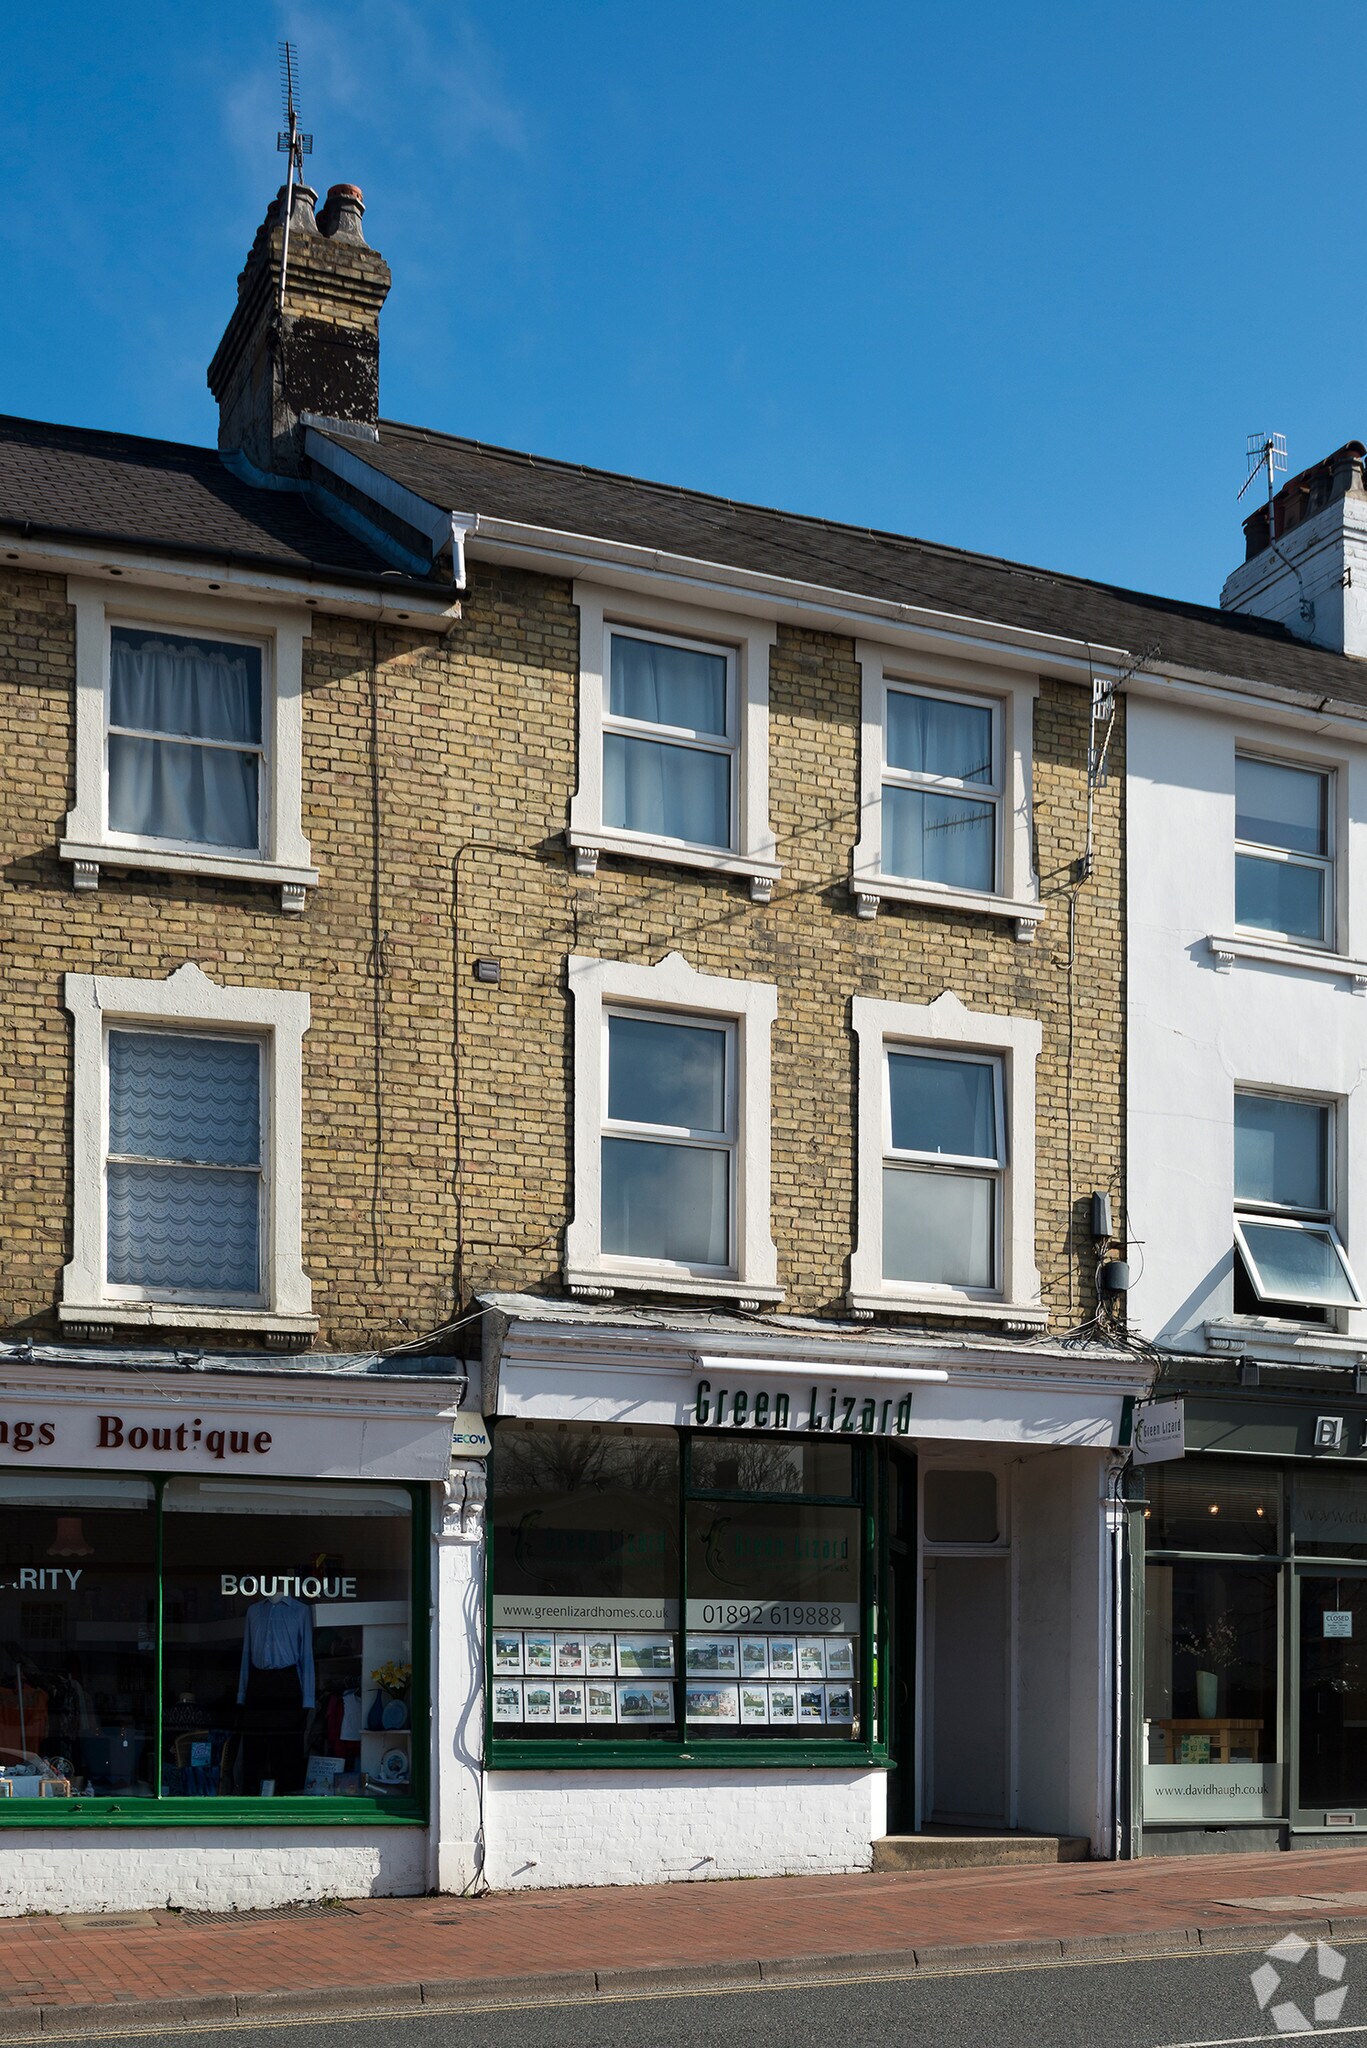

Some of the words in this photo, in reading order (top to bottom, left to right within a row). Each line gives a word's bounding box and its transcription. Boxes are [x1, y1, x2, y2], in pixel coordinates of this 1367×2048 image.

[695, 1379, 790, 1428] Green
[809, 1386, 913, 1435] Lizard
[96, 1415, 273, 1459] Boutique
[1143, 1423, 1161, 1438] Green
[1162, 1418, 1181, 1434] Lizard
[609, 1528, 667, 1553] Lizard
[735, 1532, 785, 1559] Green
[794, 1535, 849, 1560] Lizard
[0, 1568, 83, 1591] RITY
[220, 1573, 357, 1599] BOUTIQUE
[502, 1604, 669, 1620] www.greenlizardhomes.co.uk
[703, 1604, 763, 1625] 01892
[770, 1606, 842, 1626] 619888
[1155, 1783, 1269, 1798] www.davidhaugh.co.uk
